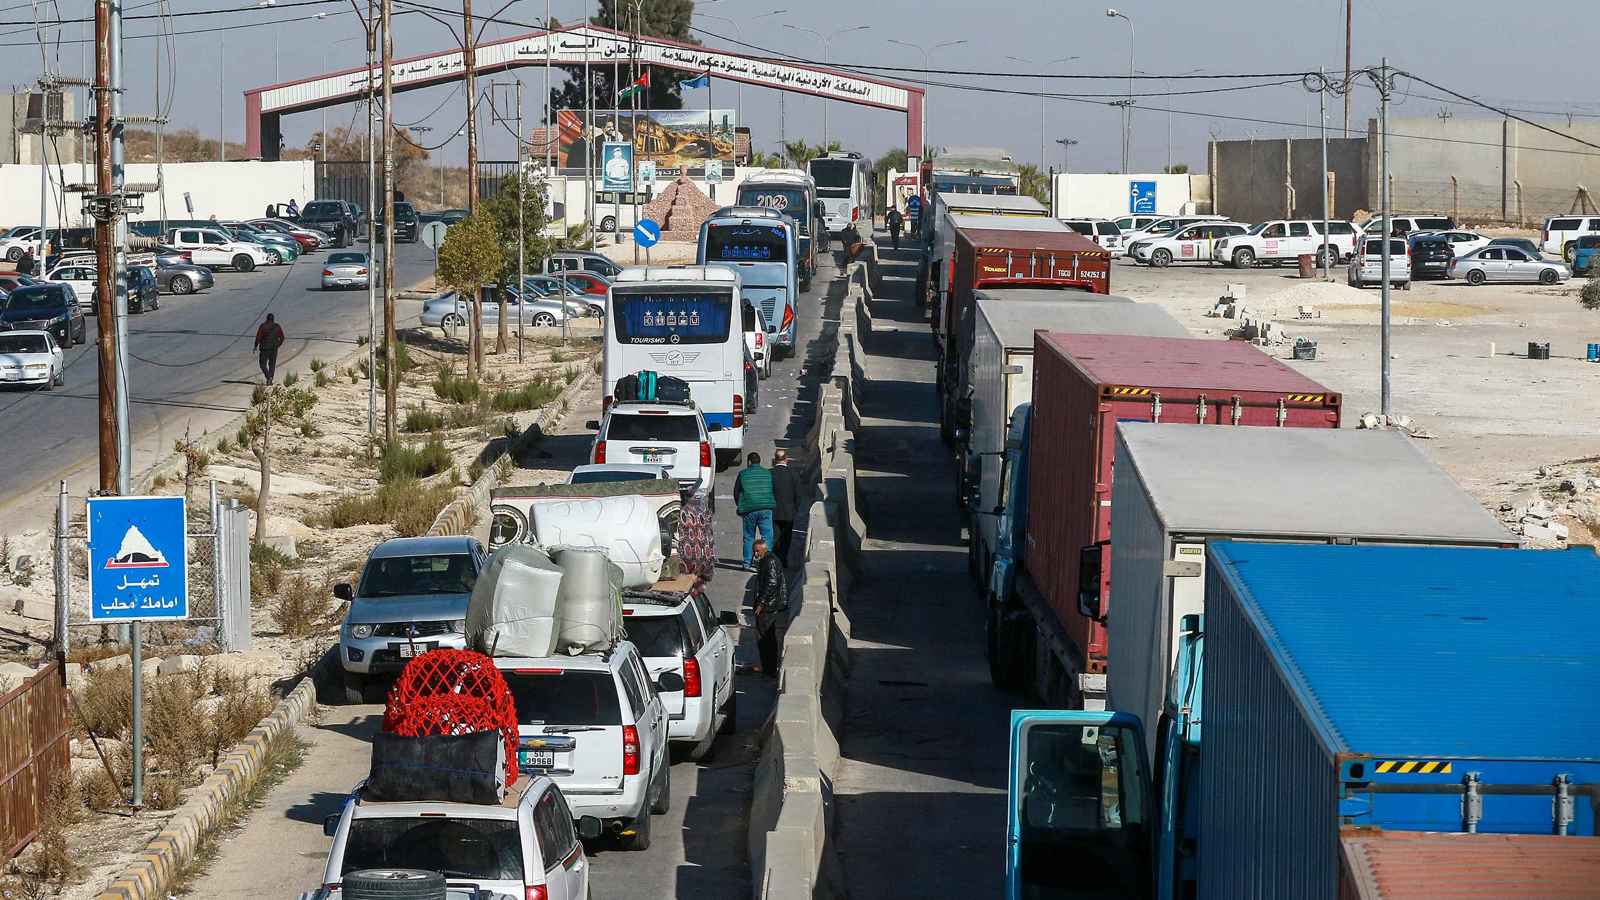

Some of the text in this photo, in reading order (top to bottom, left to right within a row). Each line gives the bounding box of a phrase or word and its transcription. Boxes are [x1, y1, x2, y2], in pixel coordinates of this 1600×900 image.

[560, 37, 600, 49] الله
[604, 43, 643, 57] الوطن
[661, 48, 698, 64] السلامة
[751, 63, 795, 82] الهاشمية
[795, 72, 832, 89] الأردنية
[833, 81, 871, 97] المملكة
[117, 574, 160, 590] تمهل
[141, 597, 178, 609] امامك
[527, 757, 551, 765] 39968
